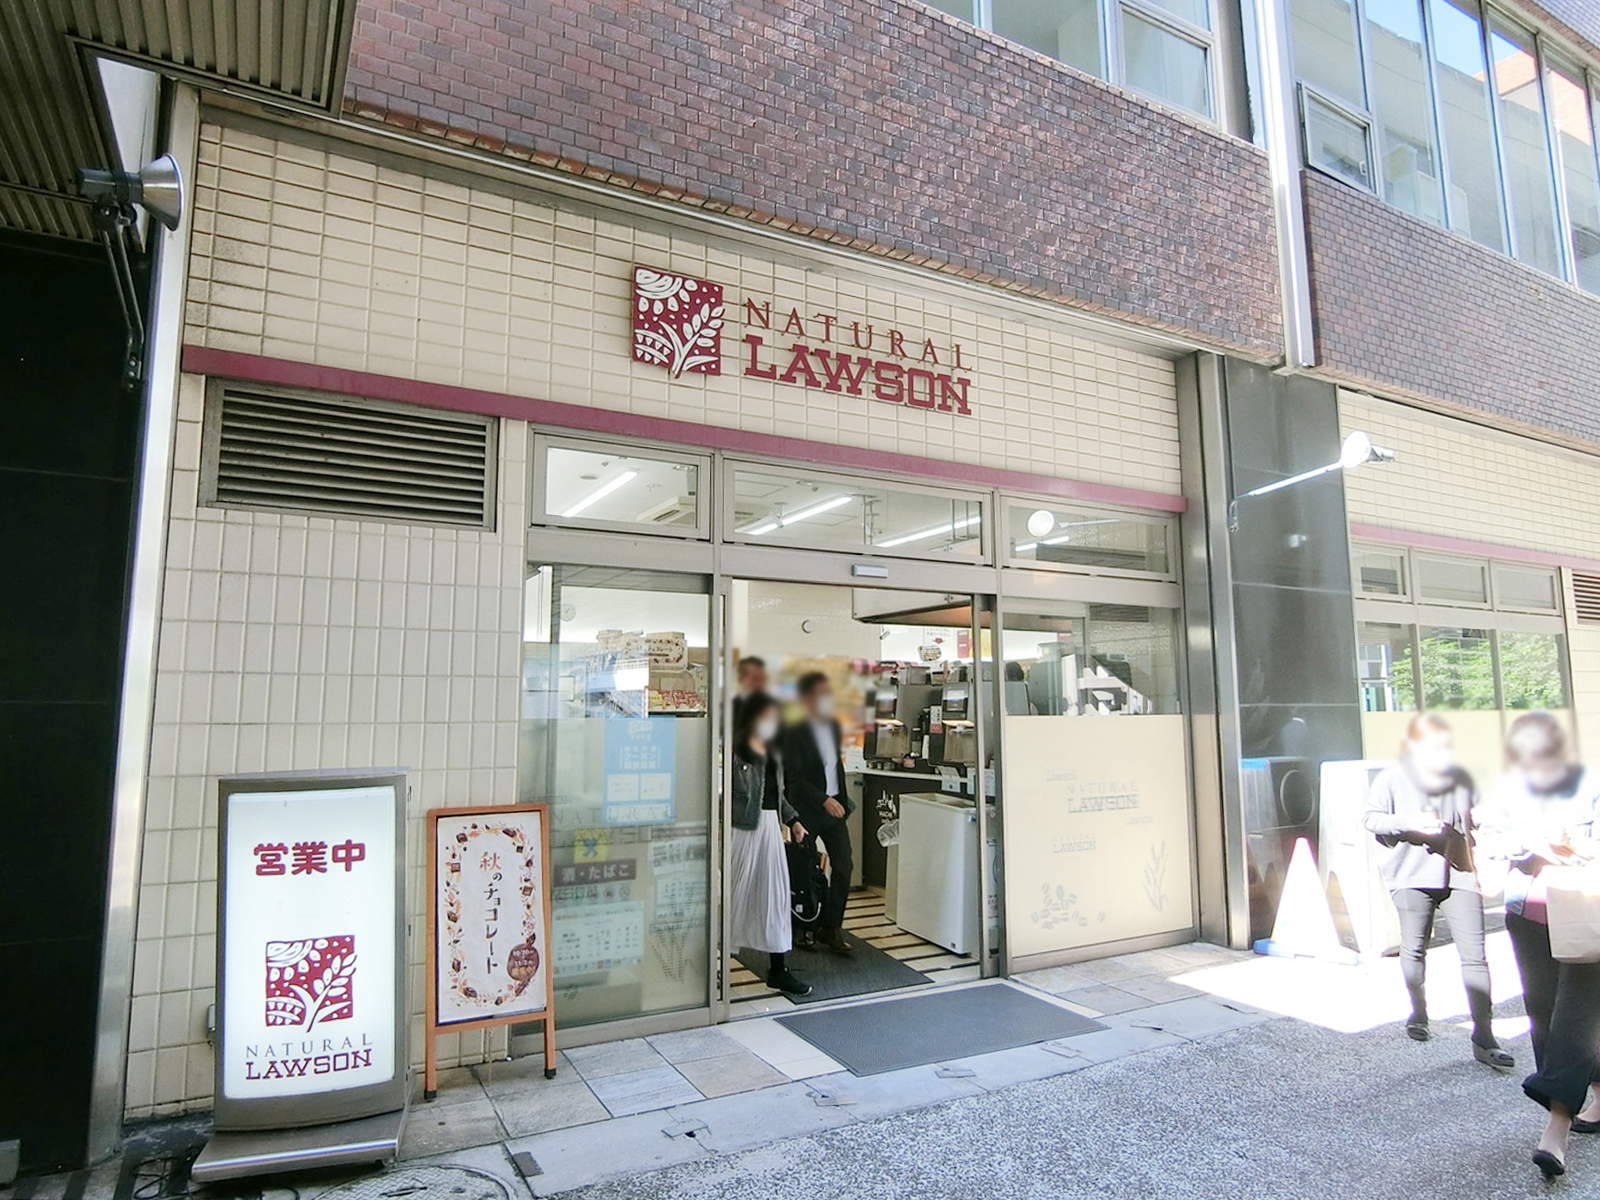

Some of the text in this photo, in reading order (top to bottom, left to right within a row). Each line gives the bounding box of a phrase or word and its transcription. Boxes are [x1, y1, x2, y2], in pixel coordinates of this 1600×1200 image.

[744, 297, 972, 372] NATURAL
[743, 334, 972, 415] LAWSON
[1066, 780, 1139, 795] NATURAL
[1067, 794, 1139, 814] LAWSON
[253, 839, 366, 876] 営業中
[1053, 841, 1097, 854] LAWSON
[480, 851, 502, 974] 秋のチョコレート
[246, 1033, 373, 1058] NATURAL
[246, 1049, 372, 1081] LAWSON
